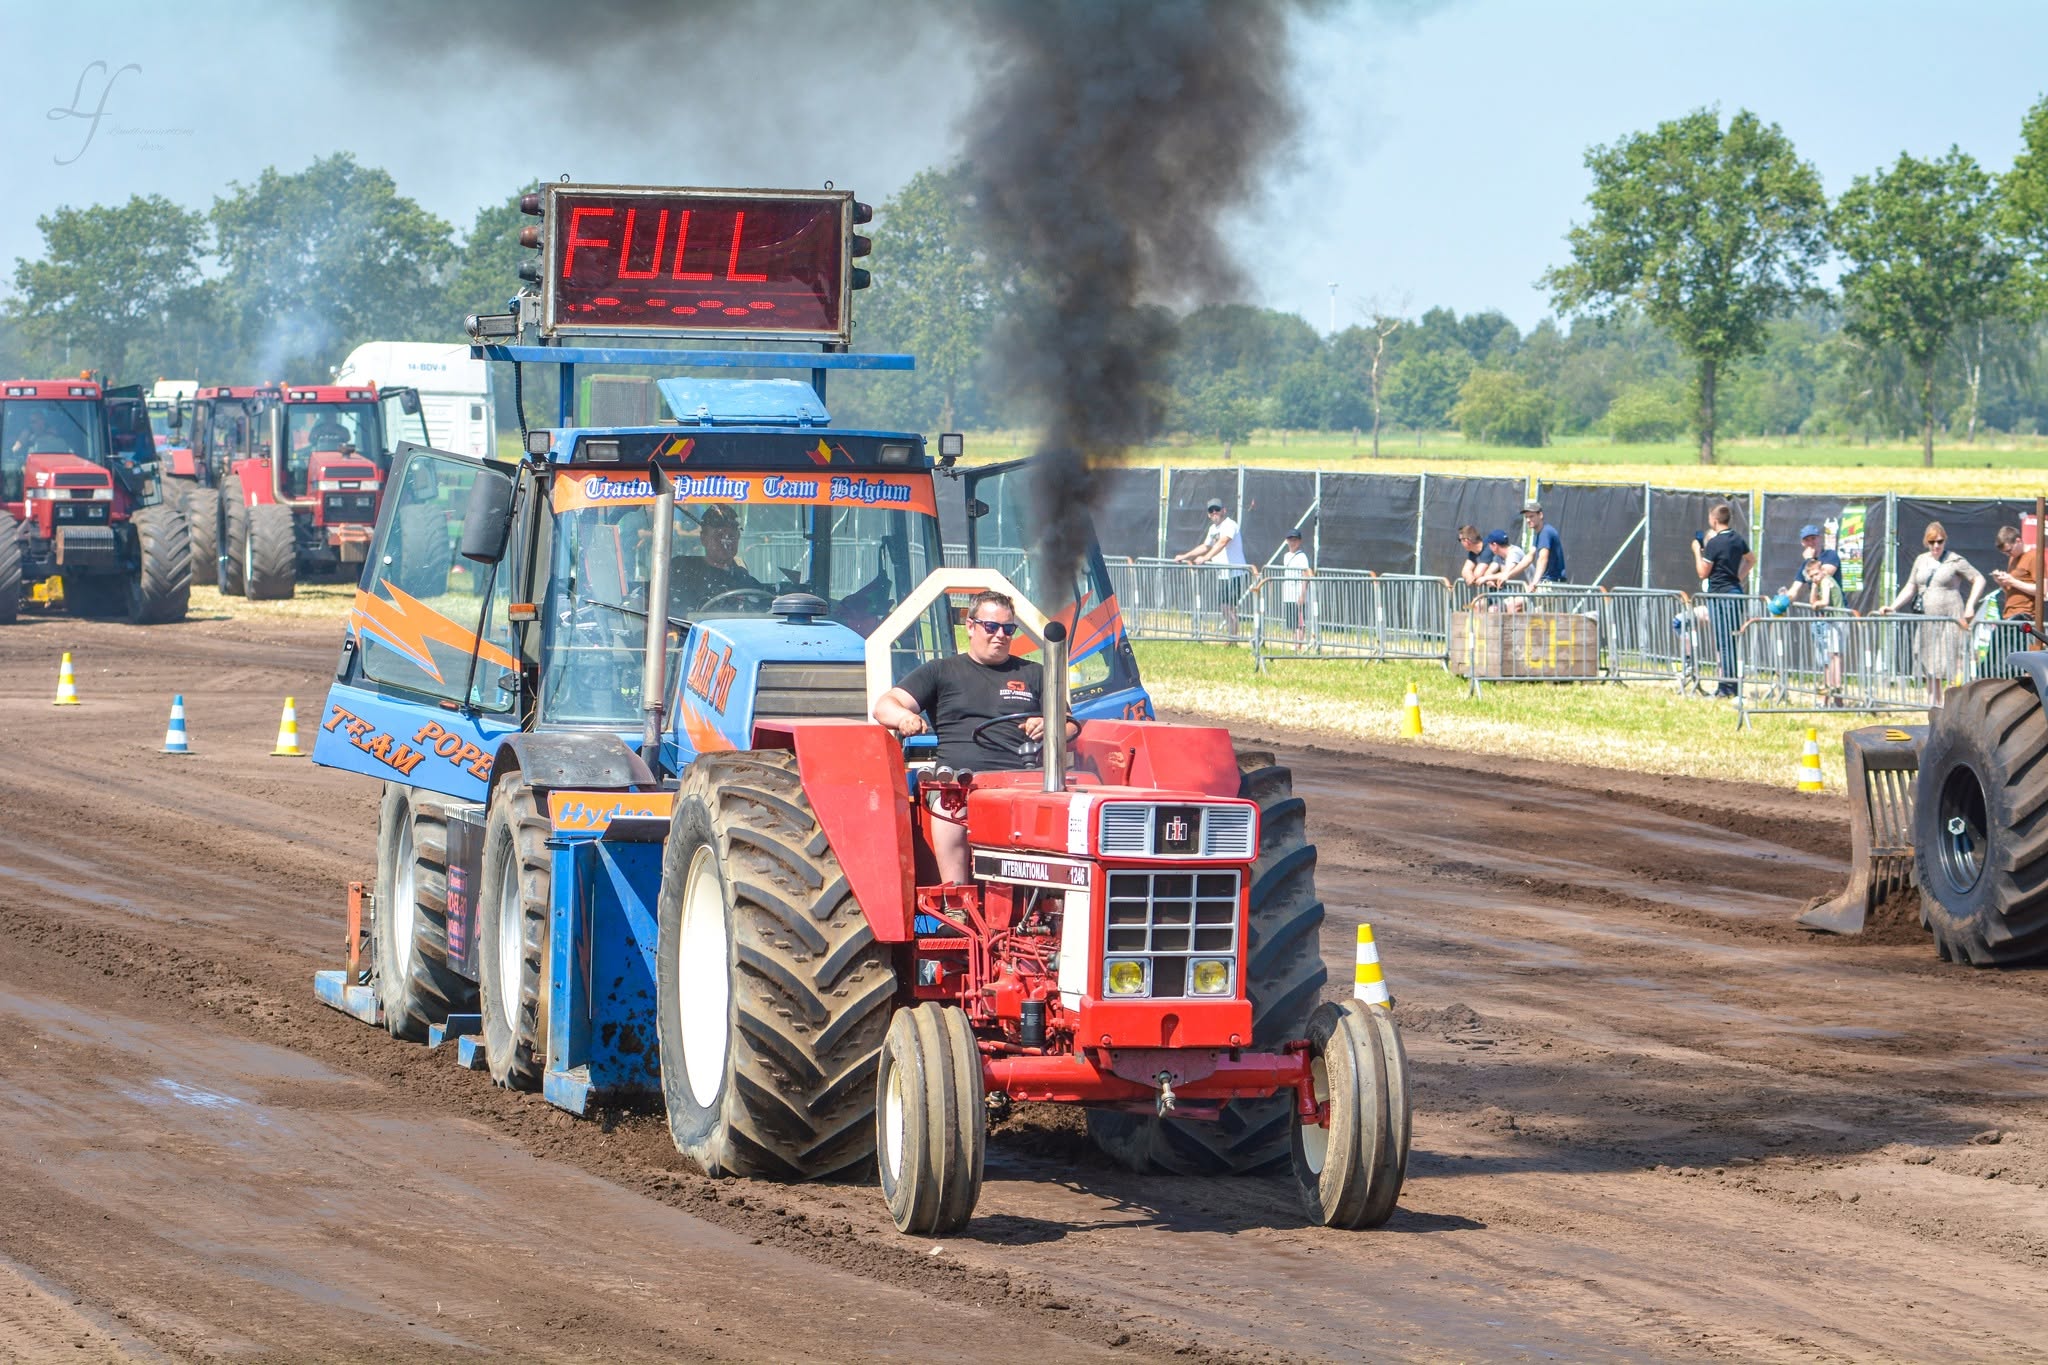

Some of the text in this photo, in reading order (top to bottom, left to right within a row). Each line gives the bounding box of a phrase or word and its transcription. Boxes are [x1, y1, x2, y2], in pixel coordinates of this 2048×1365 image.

[562, 207, 769, 283] FULL
[672, 475, 749, 500] Pulling
[762, 476, 818, 498] Team
[830, 477, 911, 503] Belgium
[323, 704, 425, 777] TEAM
[1001, 859, 1085, 885] INTERNATIONAL 1246
